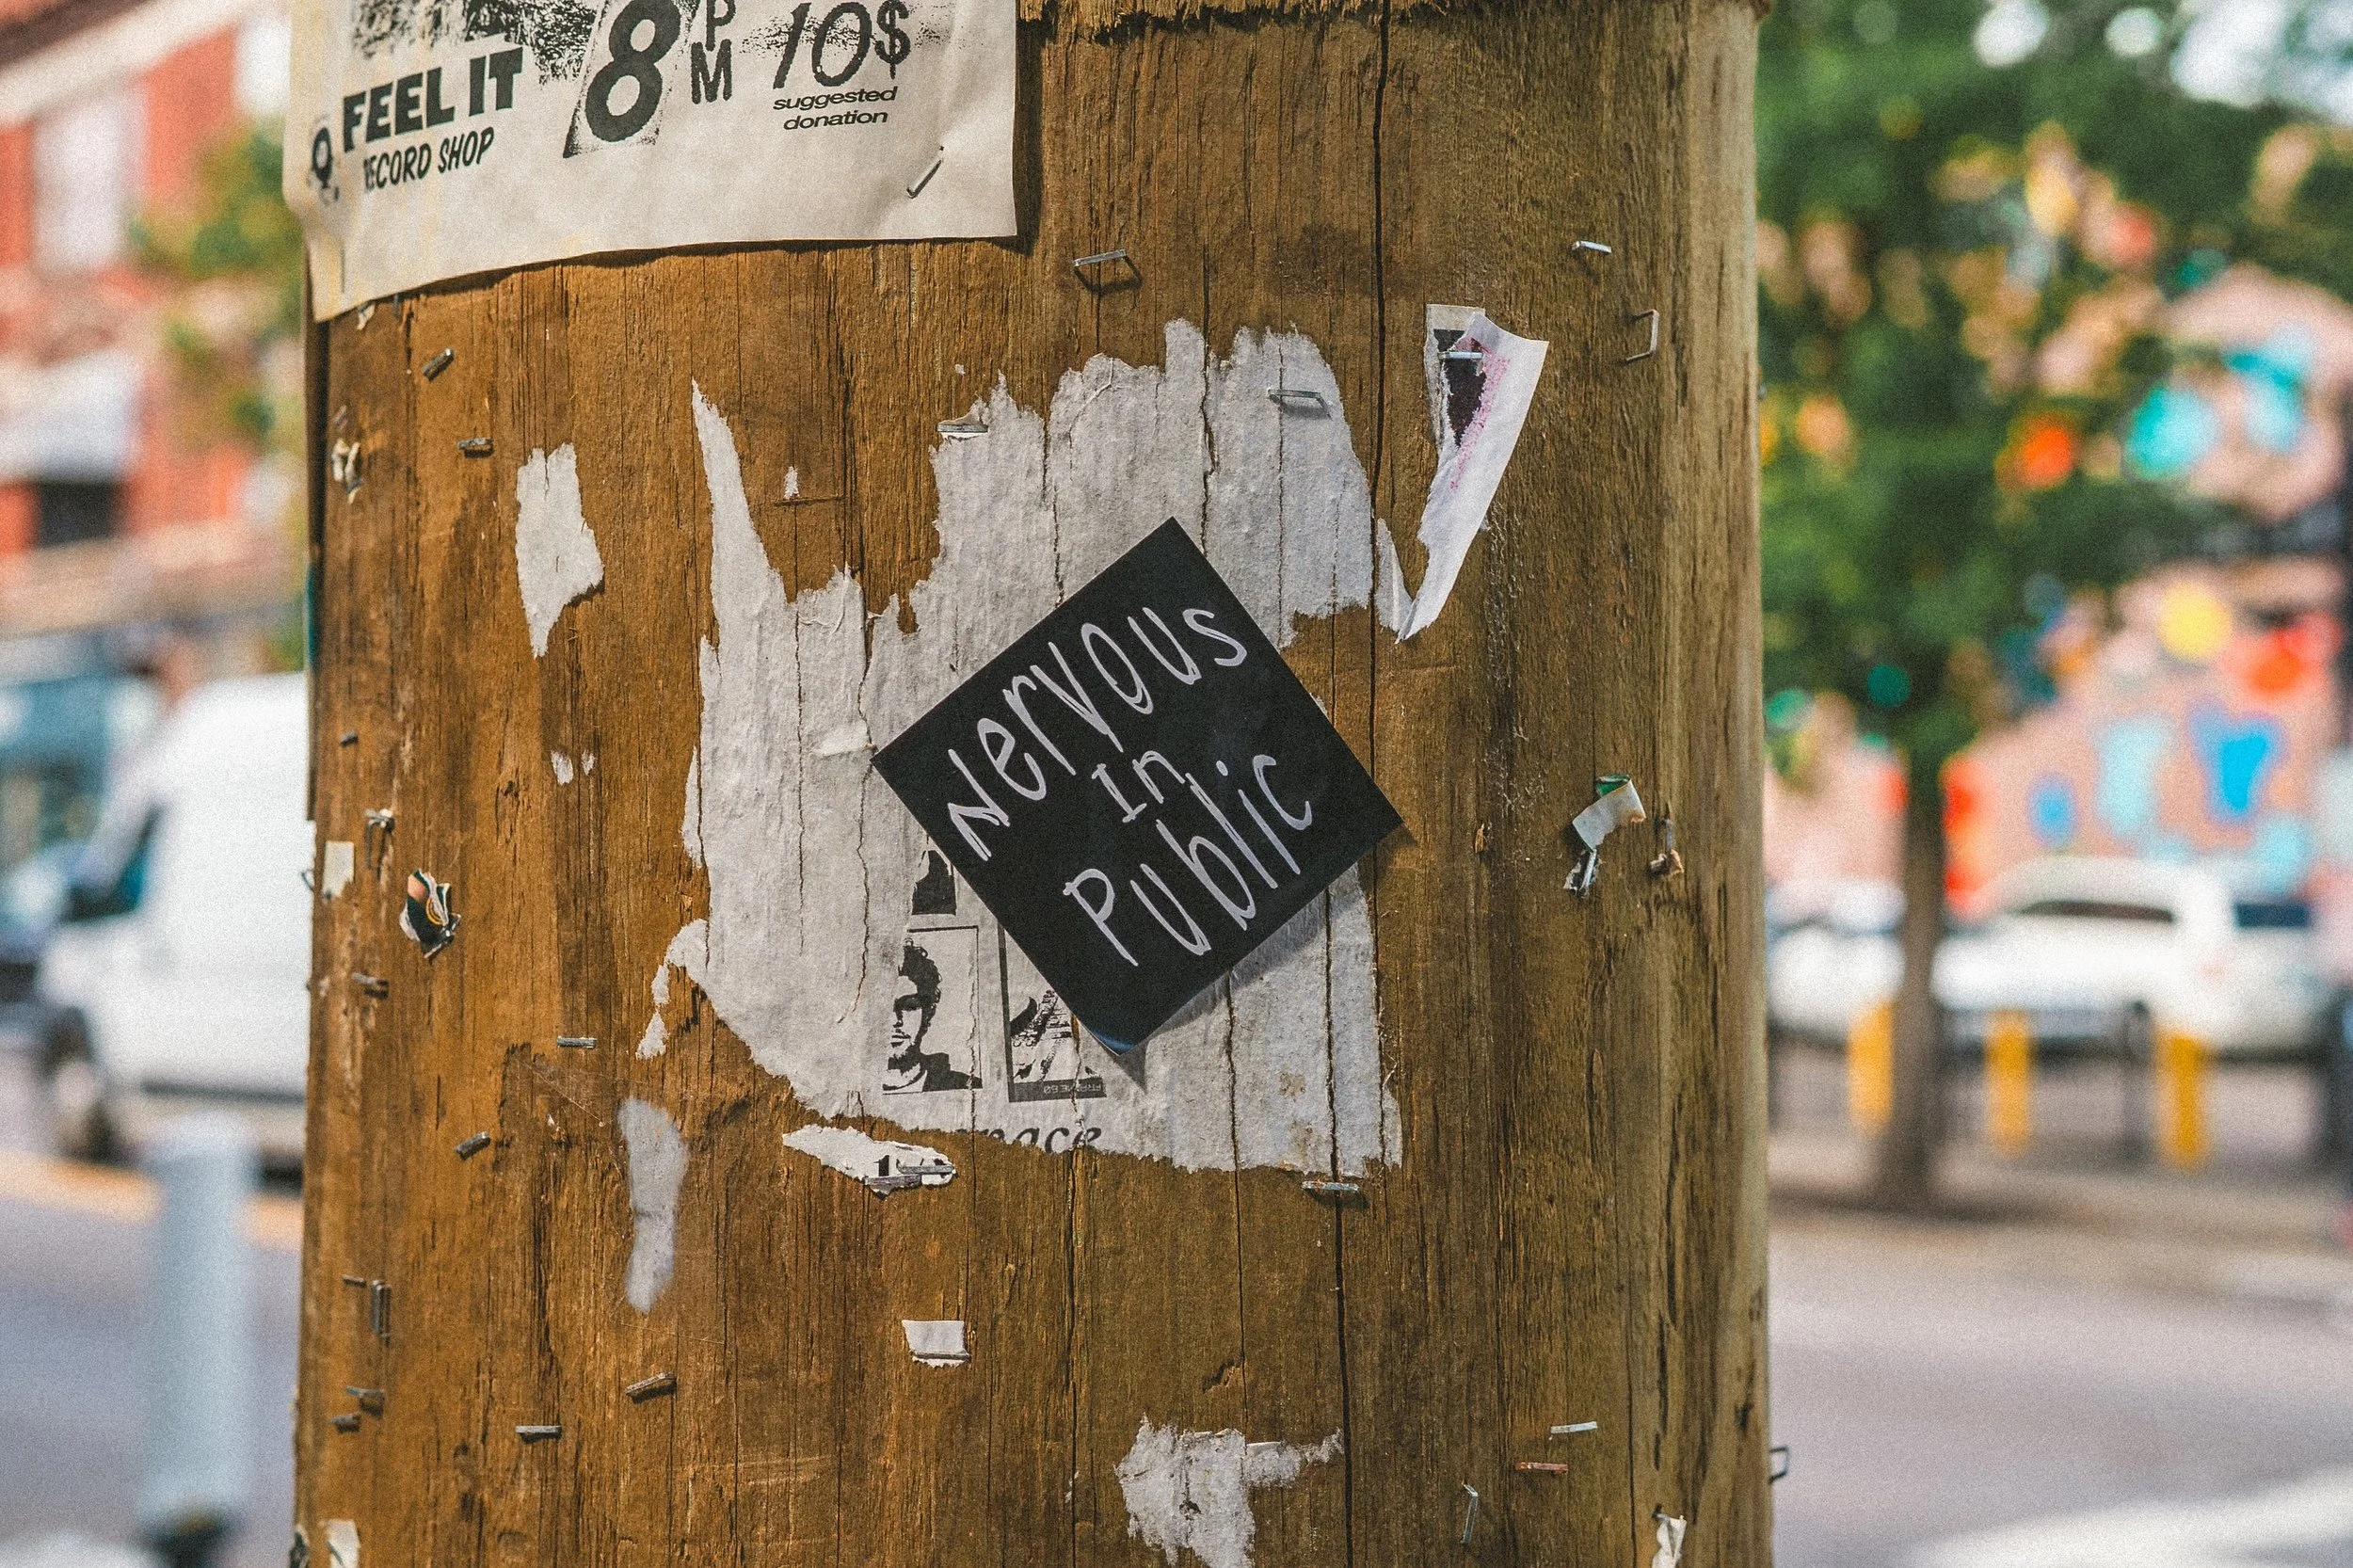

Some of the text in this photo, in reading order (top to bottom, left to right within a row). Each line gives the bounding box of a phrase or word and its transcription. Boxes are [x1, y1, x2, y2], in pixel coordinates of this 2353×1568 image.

[585, 0, 682, 143] 8
[773, 0, 911, 89] 10$
[343, 47, 523, 153] FEEL IT
[773, 87, 899, 110] suggested
[783, 110, 888, 130] donation
[363, 126, 495, 192] ECORD SHOP
